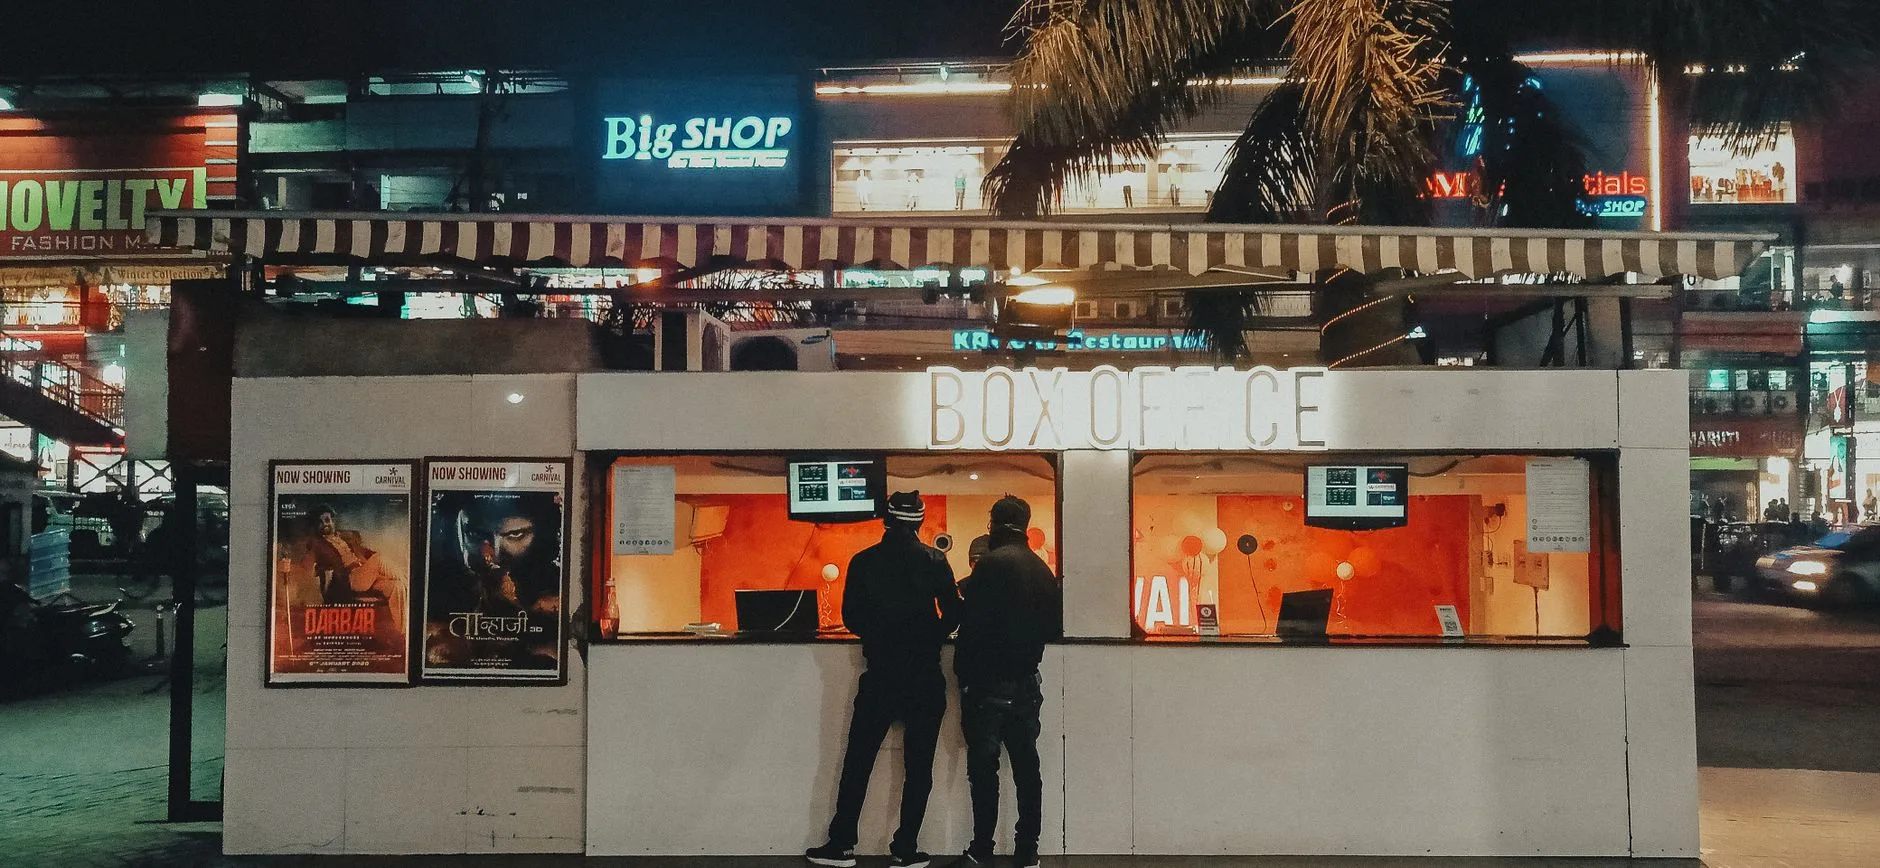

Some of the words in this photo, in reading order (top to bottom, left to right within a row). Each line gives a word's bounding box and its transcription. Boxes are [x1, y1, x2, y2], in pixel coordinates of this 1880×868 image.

[602, 114, 677, 160] Big
[682, 116, 792, 149] SHOP
[1582, 171, 1646, 195] tials
[1602, 200, 1645, 214] SHOP
[11, 235, 114, 250] FASHION
[118, 269, 149, 280] Winter
[153, 269, 203, 280] Collection
[930, 369, 1063, 448] BOX
[1090, 369, 1326, 448] OFFCE
[276, 470, 300, 484] NOW
[302, 470, 351, 484] SHOWING
[375, 476, 406, 484] CARNIVAL
[431, 467, 456, 480] NOW
[458, 467, 506, 480] SHOWING
[531, 473, 561, 482] CARNIVAL
[304, 607, 376, 635] DARBAR
